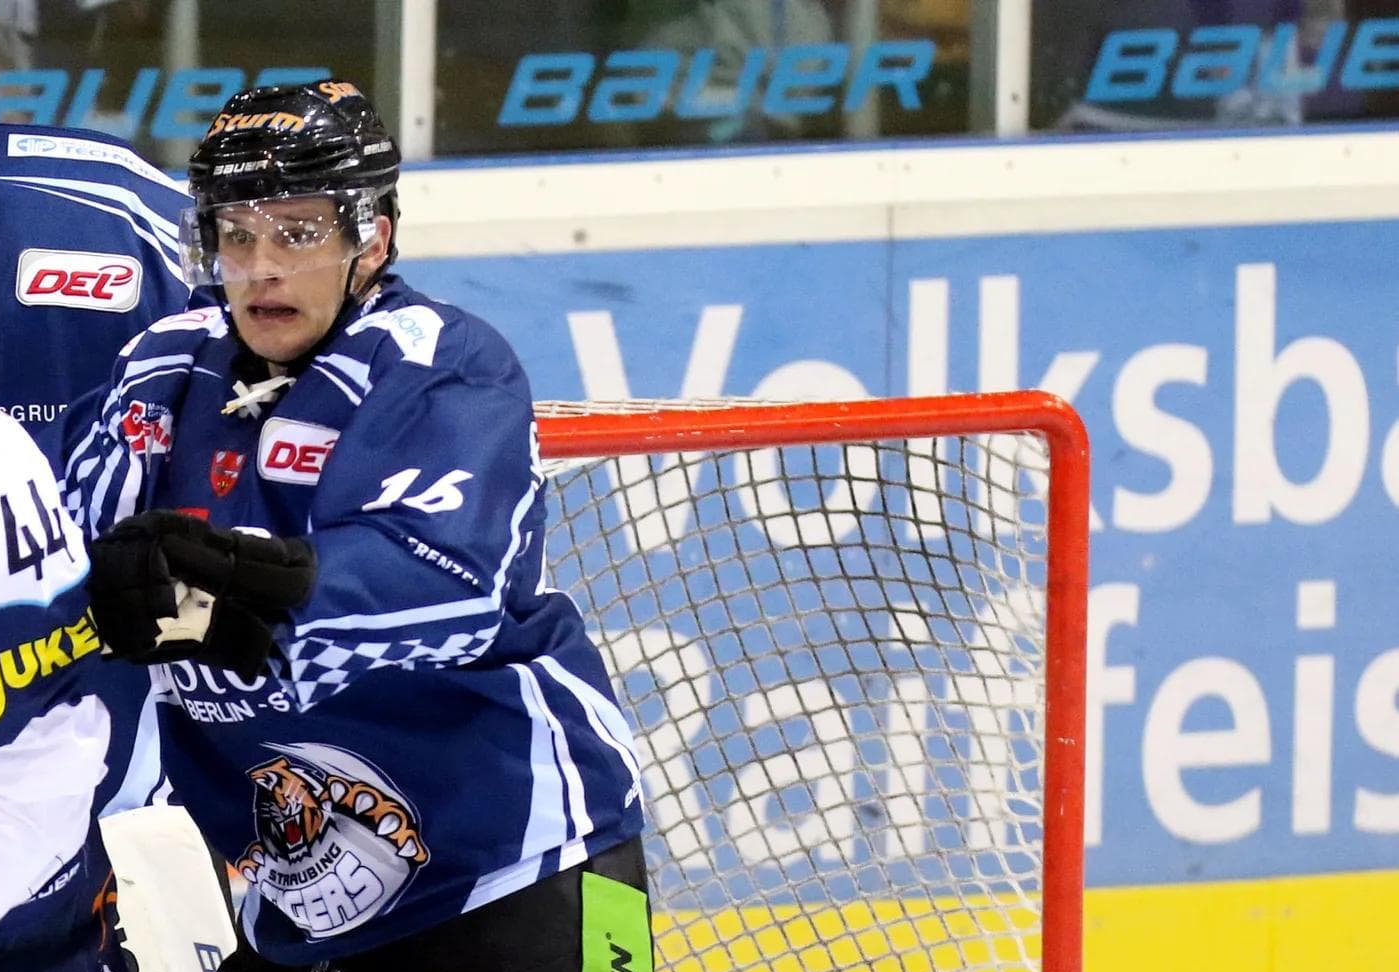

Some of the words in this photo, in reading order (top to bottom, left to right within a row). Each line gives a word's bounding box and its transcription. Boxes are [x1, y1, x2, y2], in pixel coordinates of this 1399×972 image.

[202, 111, 306, 141] Sturm
[212, 160, 269, 175] BAUER
[26, 264, 134, 301] DEL
[566, 262, 1399, 553] Volksb
[361, 468, 474, 514] 16
[0, 479, 76, 582] 44
[184, 698, 256, 723] BERLIN
[268, 841, 342, 887] STRAUBING
